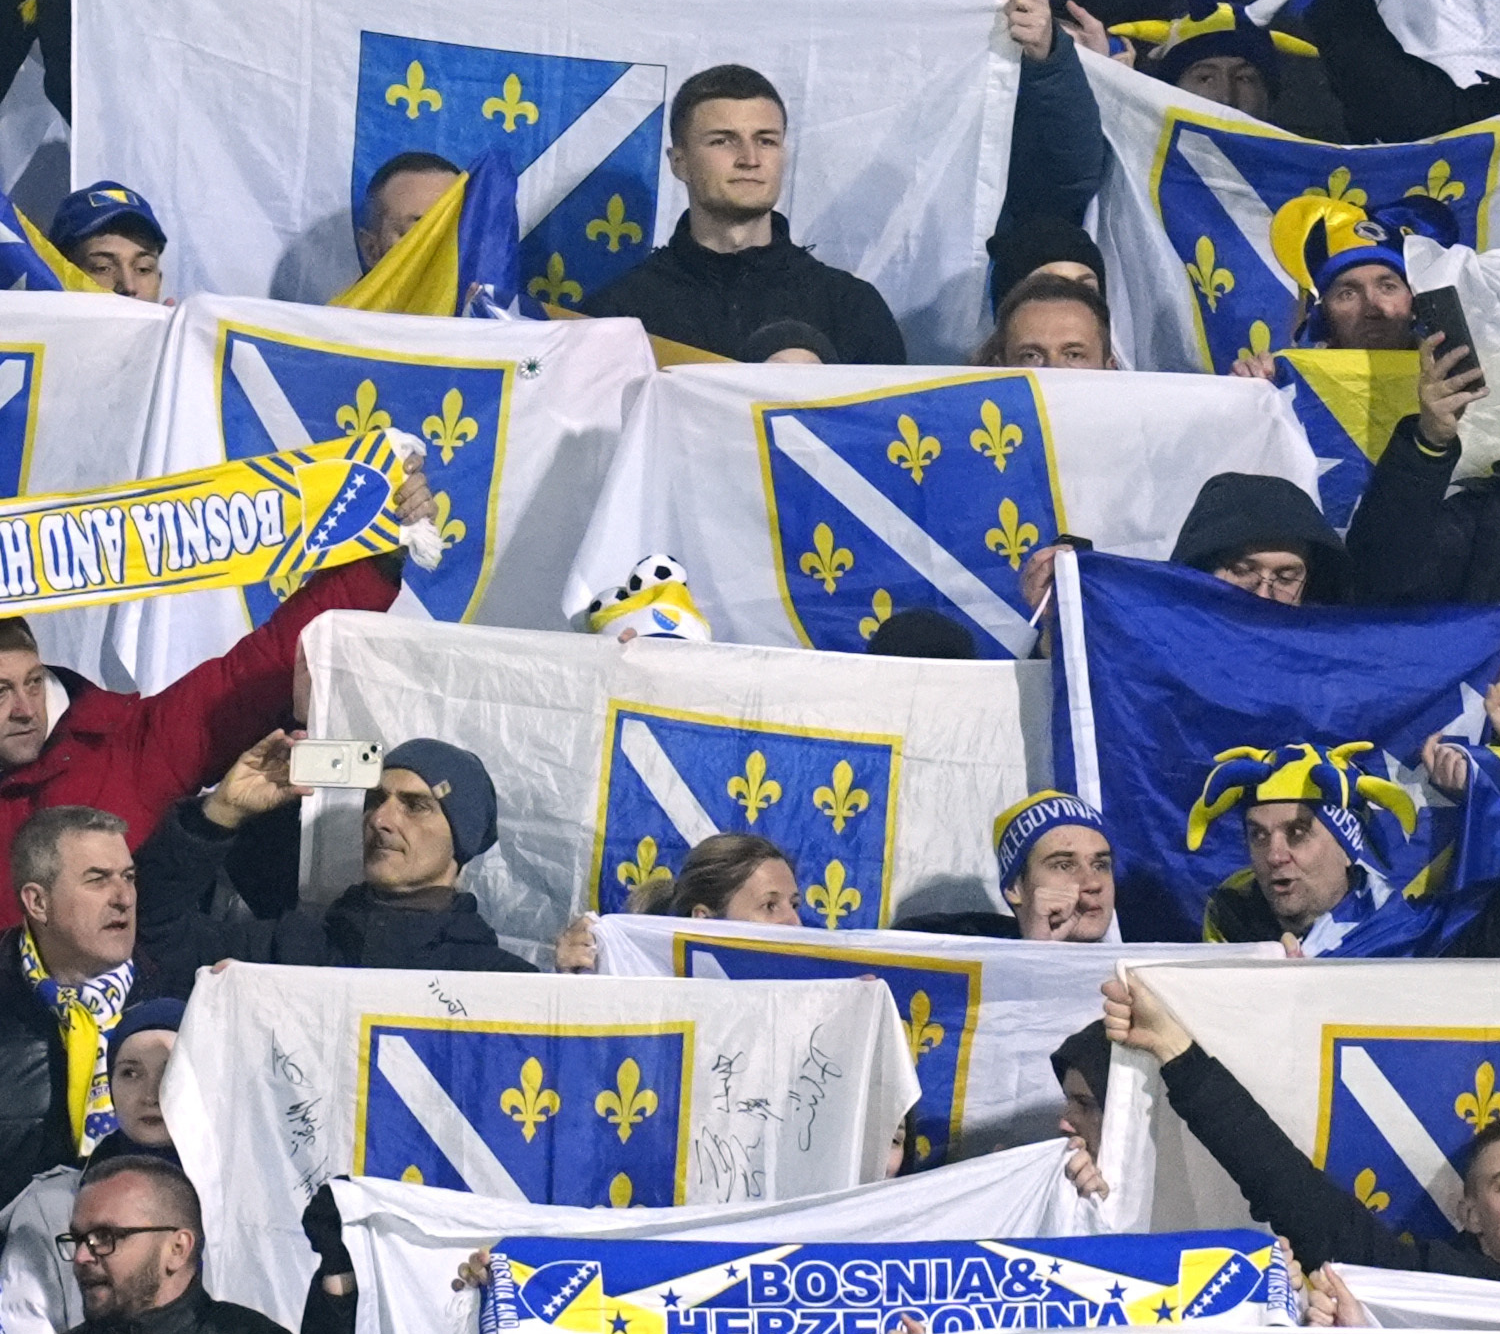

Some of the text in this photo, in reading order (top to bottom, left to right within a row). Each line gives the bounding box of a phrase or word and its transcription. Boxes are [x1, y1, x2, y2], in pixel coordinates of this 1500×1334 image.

[37, 507, 127, 589] AND
[129, 489, 284, 576] BOSNIA
[998, 795, 1102, 875] RCEGOVINA
